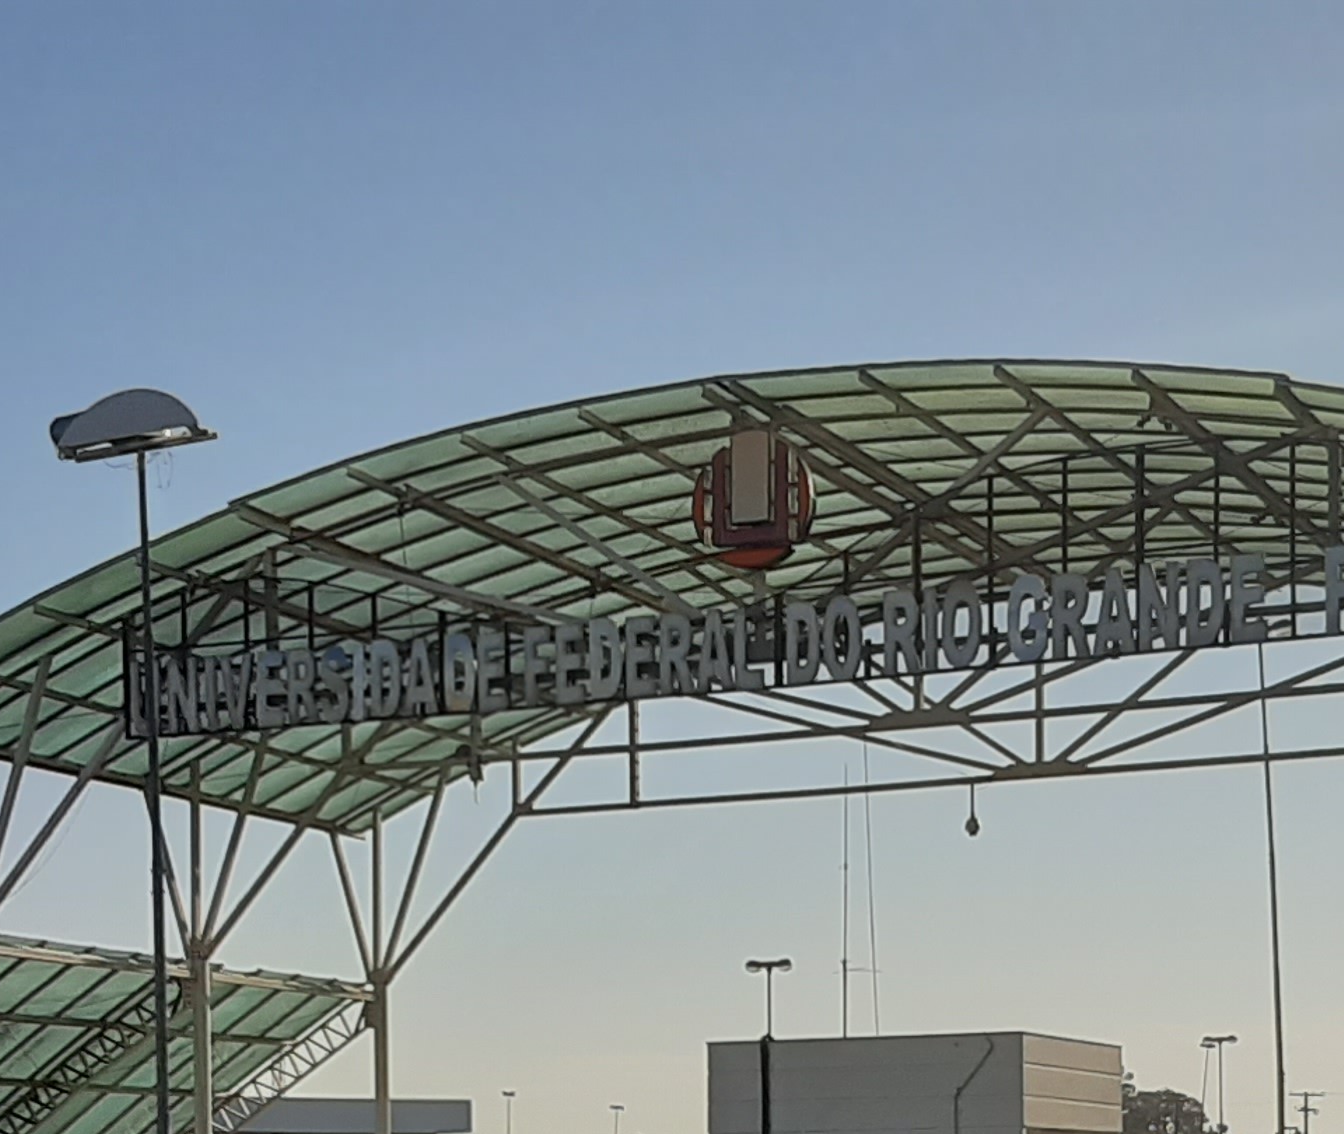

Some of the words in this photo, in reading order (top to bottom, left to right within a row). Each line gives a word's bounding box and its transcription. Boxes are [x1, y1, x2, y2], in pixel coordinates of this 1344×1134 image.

[129, 627, 508, 738] UNIVERSIDADE
[522, 608, 765, 703] FEDERAL
[785, 594, 862, 684] DO
[883, 577, 983, 674] RIO
[1007, 552, 1268, 664] GRANDE
